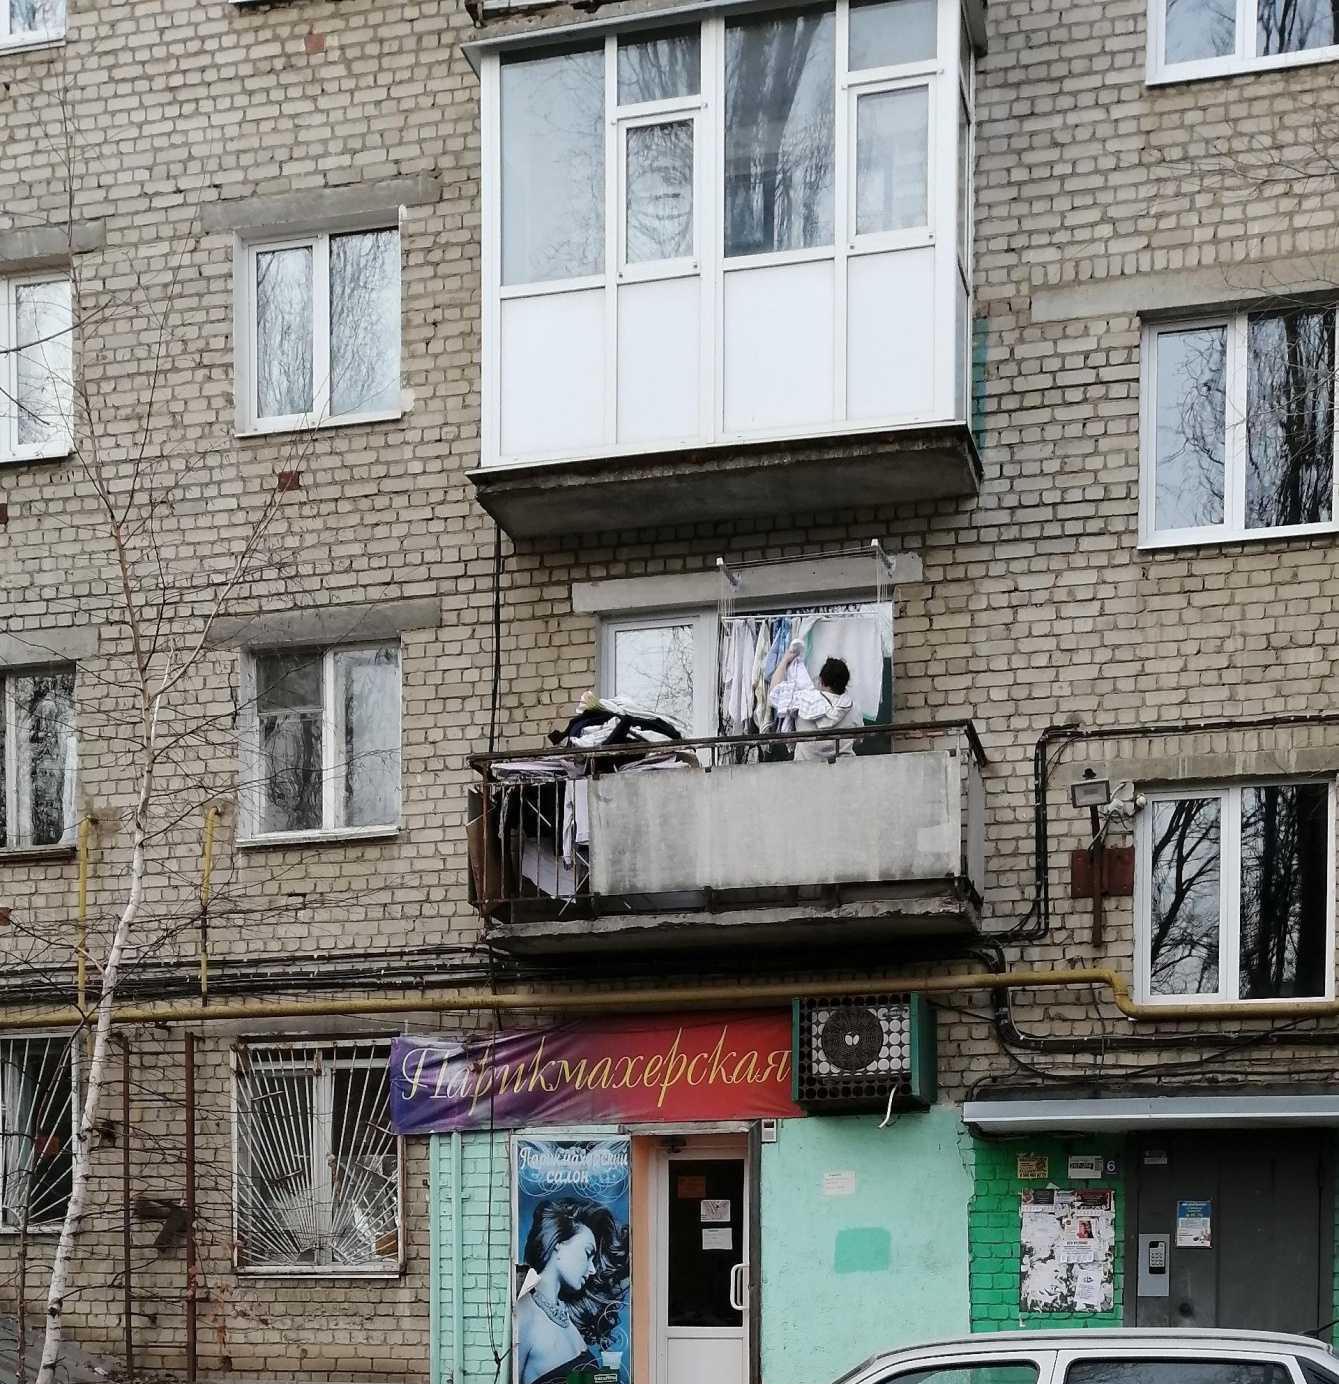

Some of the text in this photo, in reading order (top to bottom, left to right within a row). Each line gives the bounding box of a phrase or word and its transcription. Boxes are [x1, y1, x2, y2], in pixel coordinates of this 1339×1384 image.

[401, 1024, 792, 1116] Парикмахерская
[1106, 1160, 1116, 1172] 6
[546, 1169, 589, 1184] салон
